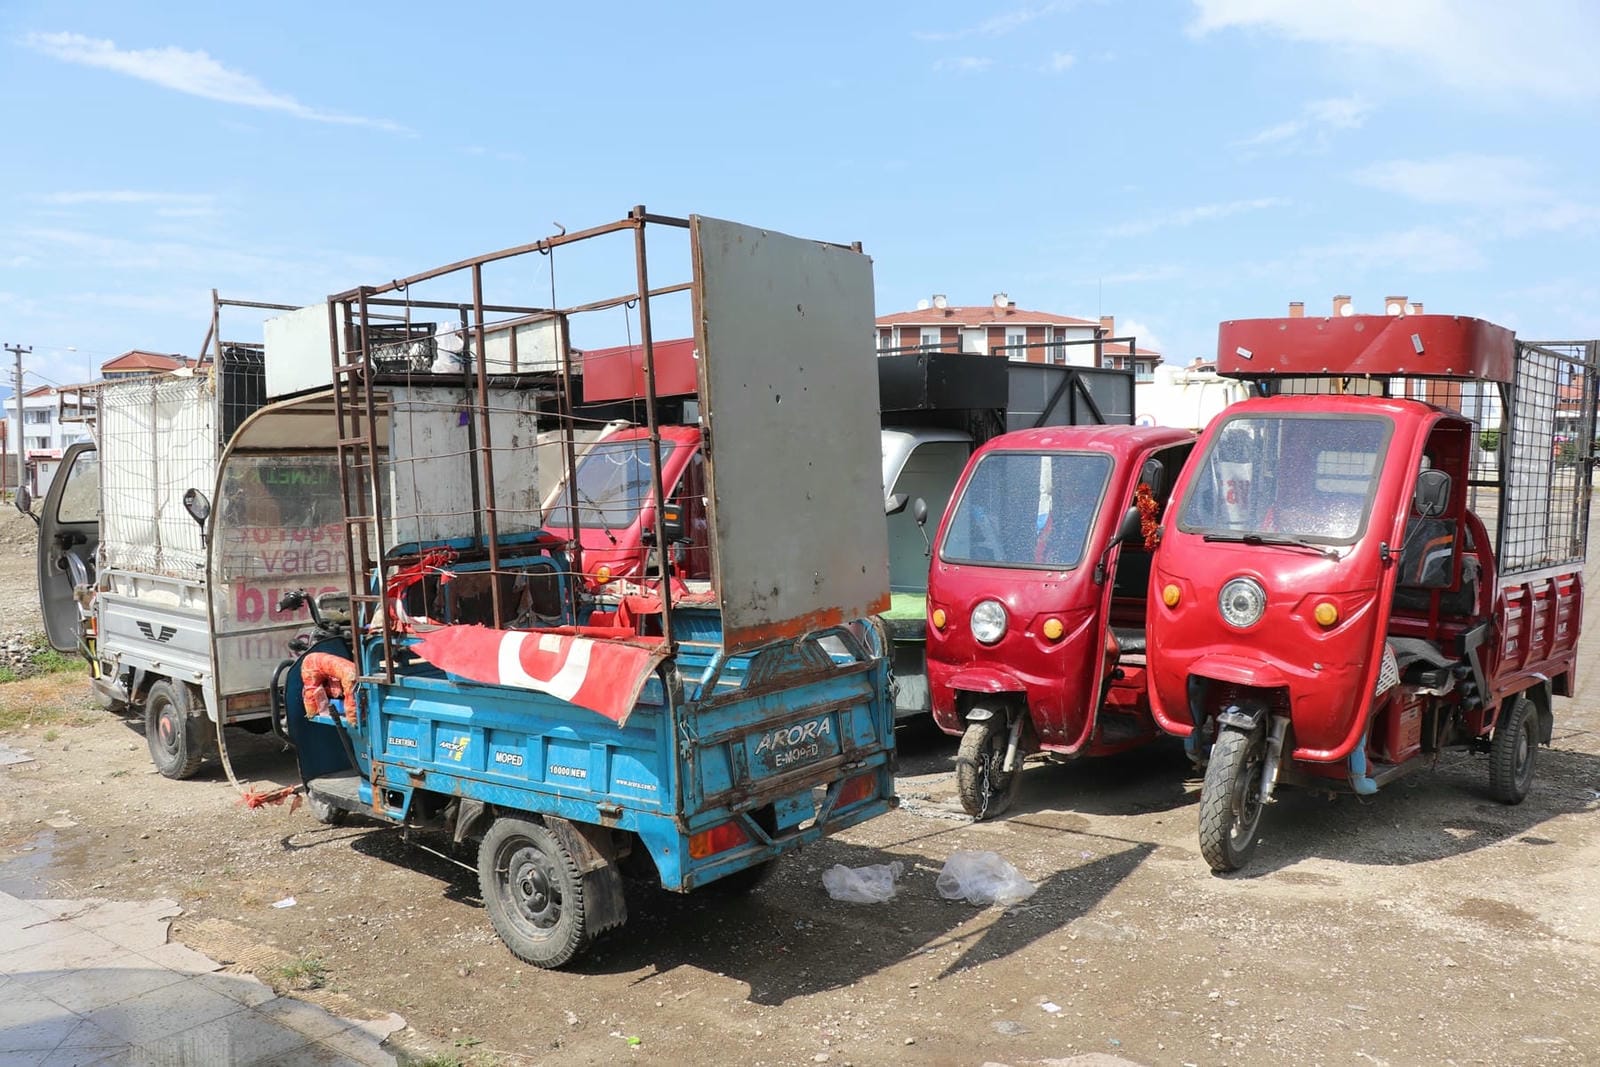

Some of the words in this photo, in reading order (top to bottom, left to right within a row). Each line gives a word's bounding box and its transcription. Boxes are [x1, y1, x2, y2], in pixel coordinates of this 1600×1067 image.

[755, 717, 830, 755] ARORA
[495, 751, 523, 766] MOPED
[550, 765, 570, 776] 10000
[571, 768, 587, 778] NEW
